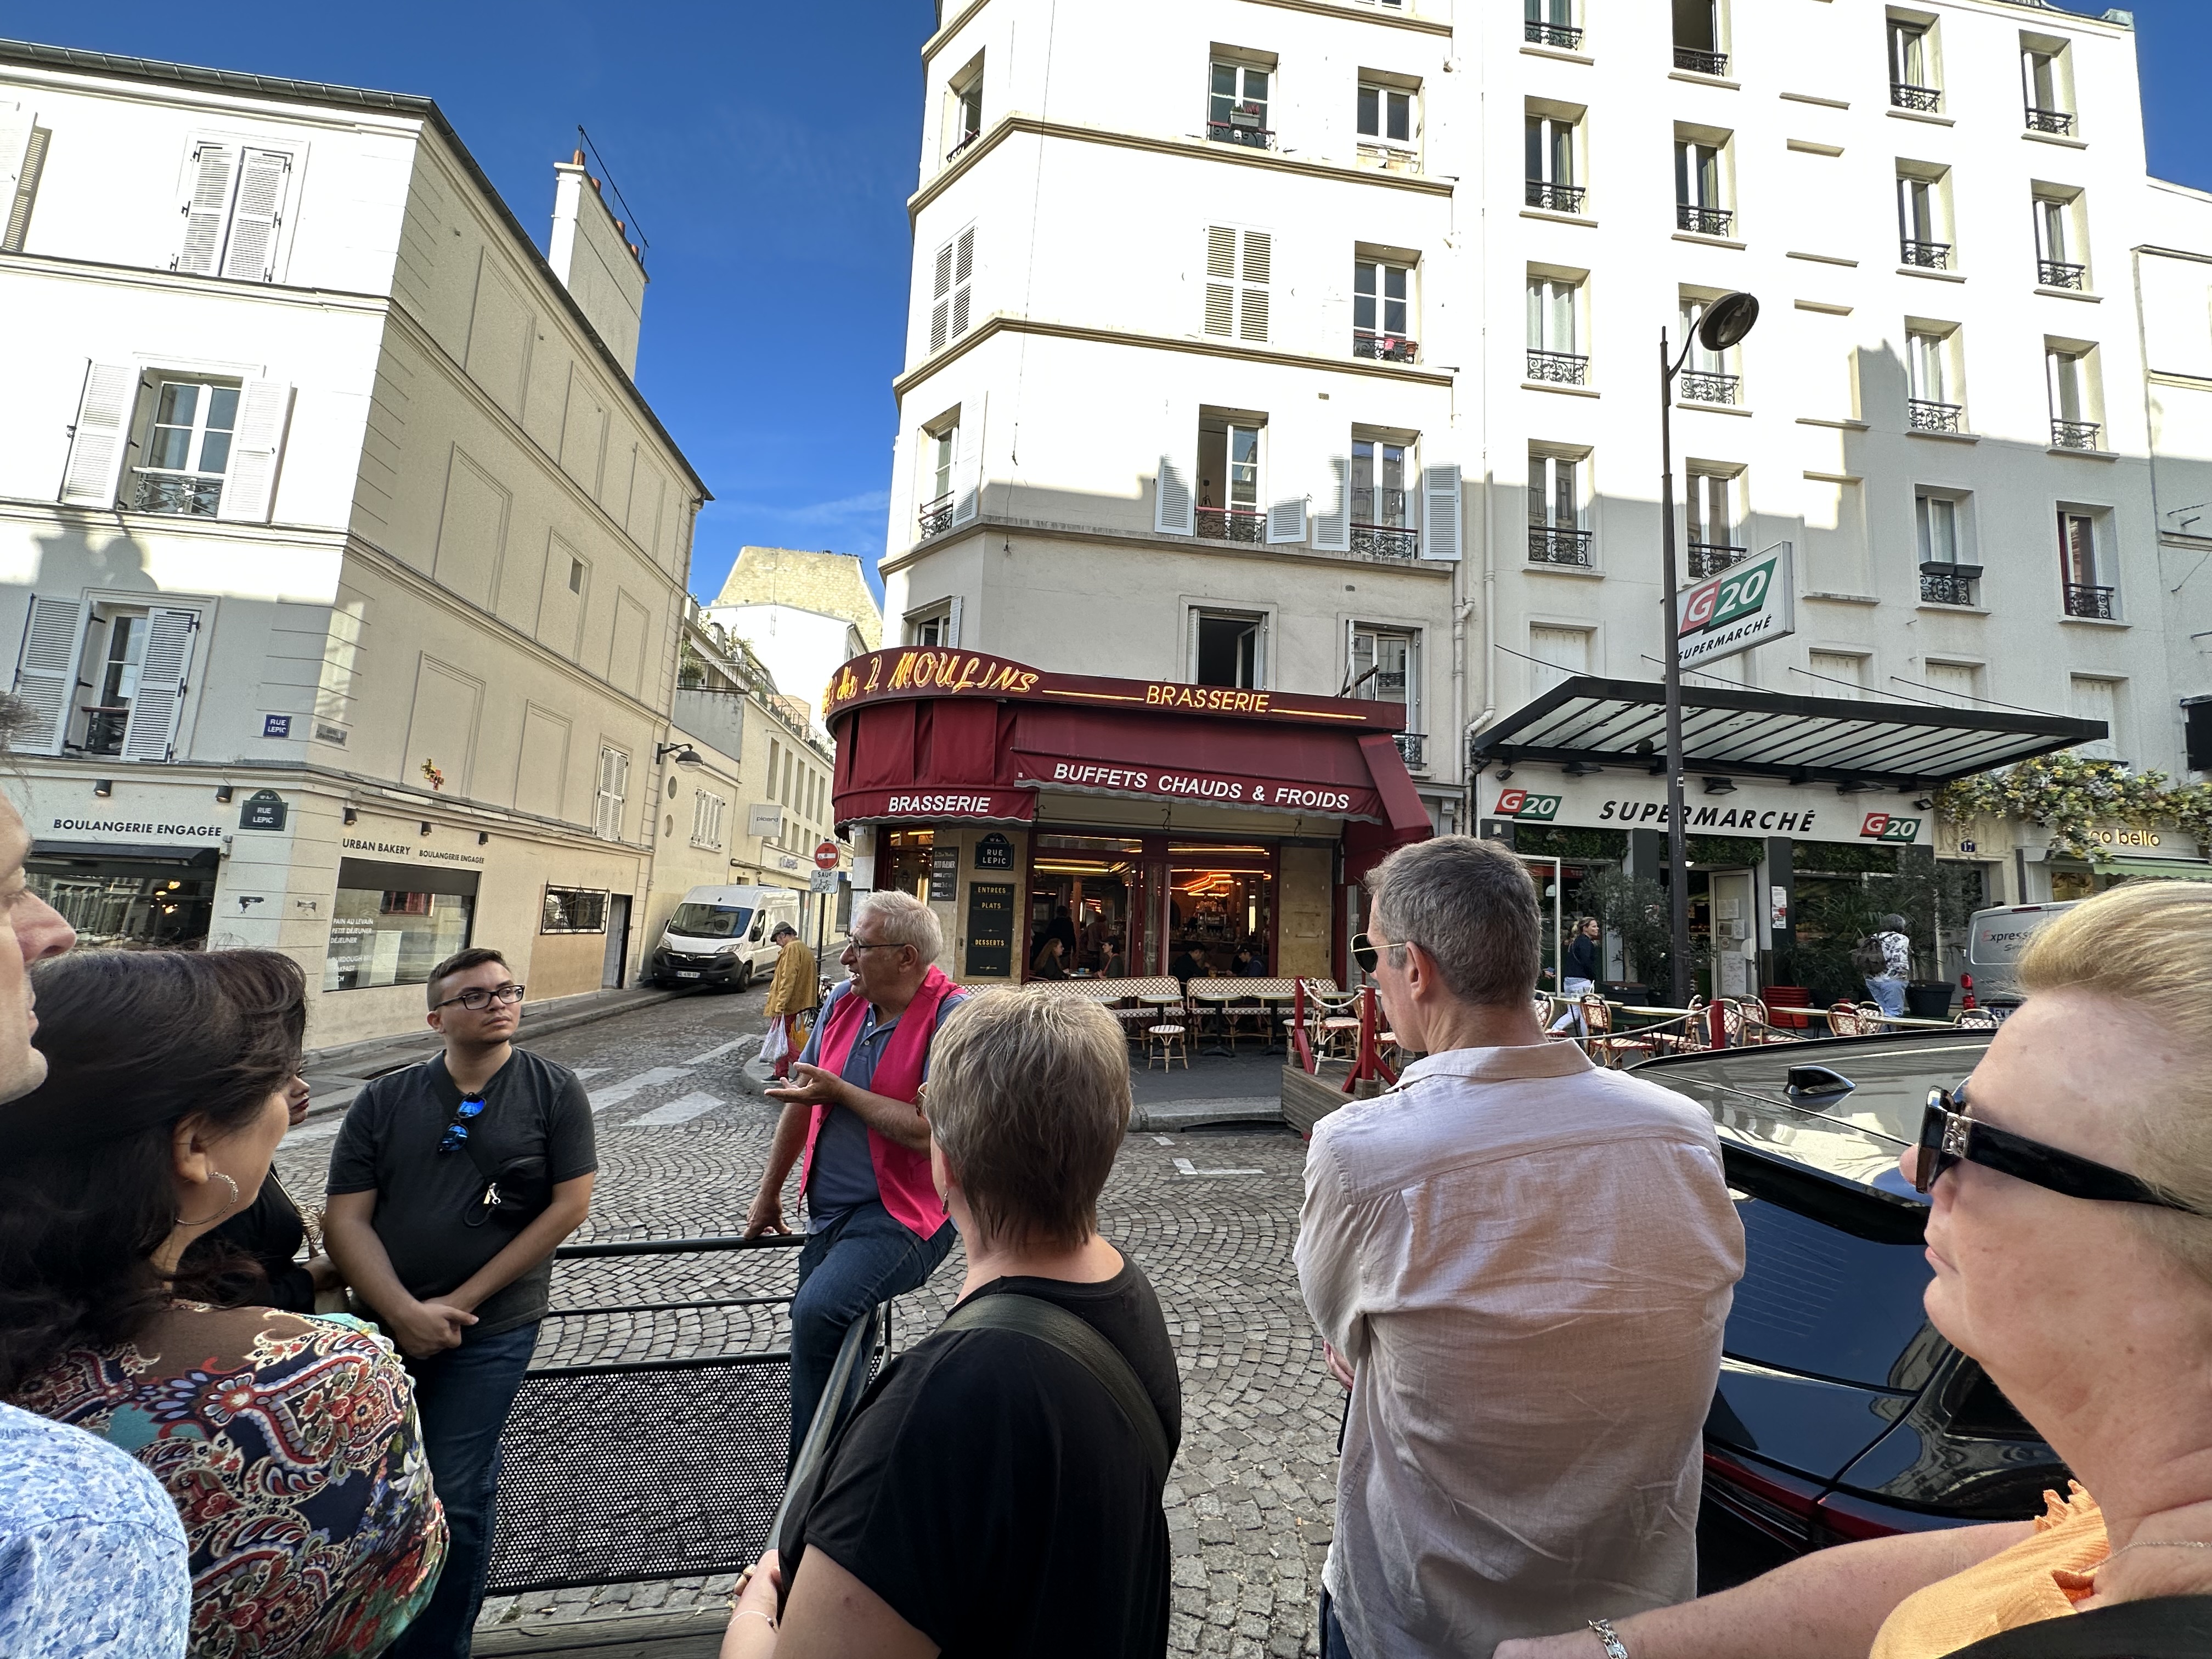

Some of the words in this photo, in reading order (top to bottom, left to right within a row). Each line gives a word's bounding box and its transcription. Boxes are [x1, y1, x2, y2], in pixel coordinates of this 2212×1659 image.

[1688, 570, 1767, 622] G20
[1679, 614, 1772, 661] SUPERMARCHÉ
[865, 654, 882, 693] 2
[887, 652, 1039, 693] MOULINS
[1146, 685, 1269, 712] BRASSERIE
[1053, 763, 1148, 788] BUFFETS
[1158, 775, 1243, 799] CHAUDS
[1252, 786, 1265, 801] &
[1275, 788, 1350, 809] FROIDS
[888, 795, 991, 812] BRASSERIE
[1501, 793, 1556, 815] G20
[1599, 800, 1815, 831] SUPERMARCHÉ
[1866, 816, 1916, 836] G20
[54, 819, 153, 833] BOULANGERIE
[157, 824, 222, 836] ENGAGÉE
[2116, 828, 2160, 847] bello
[343, 838, 376, 851] URBAN
[378, 843, 410, 855] BAKERY
[419, 850, 459, 861] BOULANGERIE
[1963, 842, 1972, 851] 17
